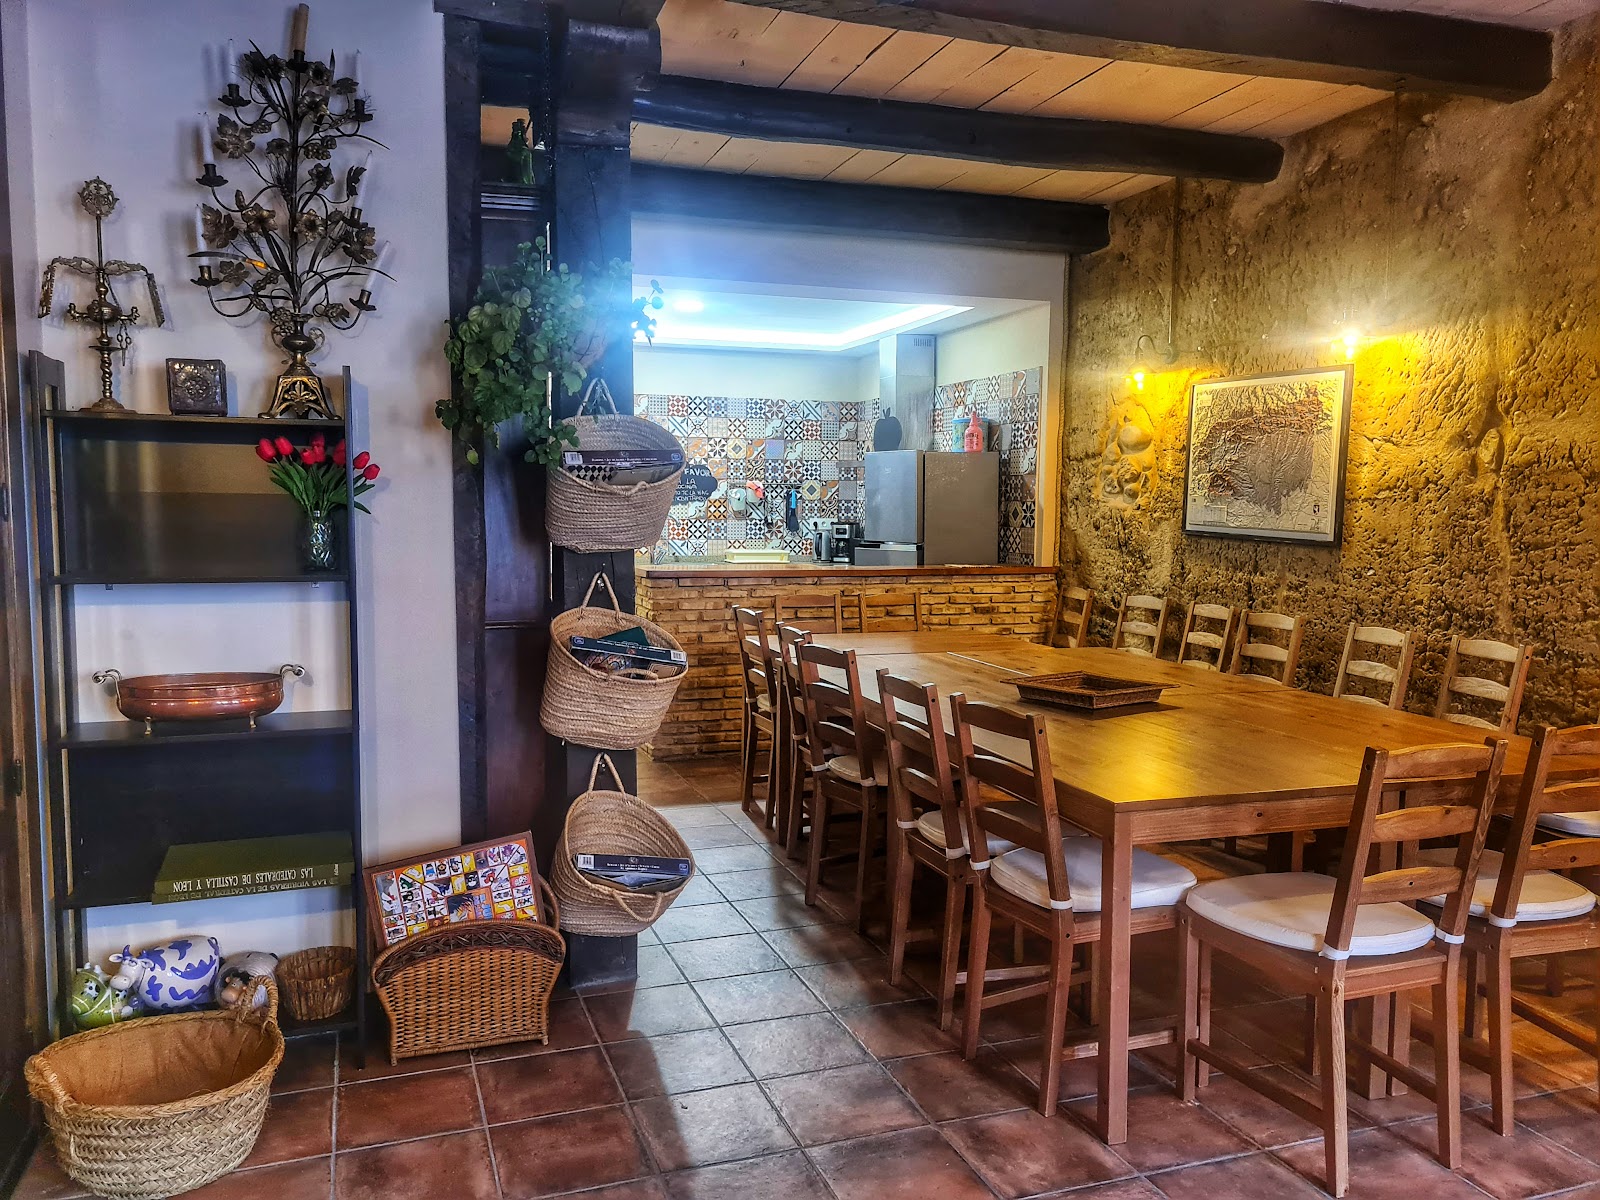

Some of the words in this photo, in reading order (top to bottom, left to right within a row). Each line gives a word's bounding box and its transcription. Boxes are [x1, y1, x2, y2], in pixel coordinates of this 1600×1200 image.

[684, 468, 711, 477] FAVOR
[256, 869, 297, 884] CATEDRALES
[301, 867, 314, 879] LAS
[196, 879, 202, 890] Y
[206, 875, 239, 889] CASTILLA
[241, 873, 252, 885] DE
[246, 886, 257, 894] LA
[270, 880, 310, 891] VIDRIERAS
